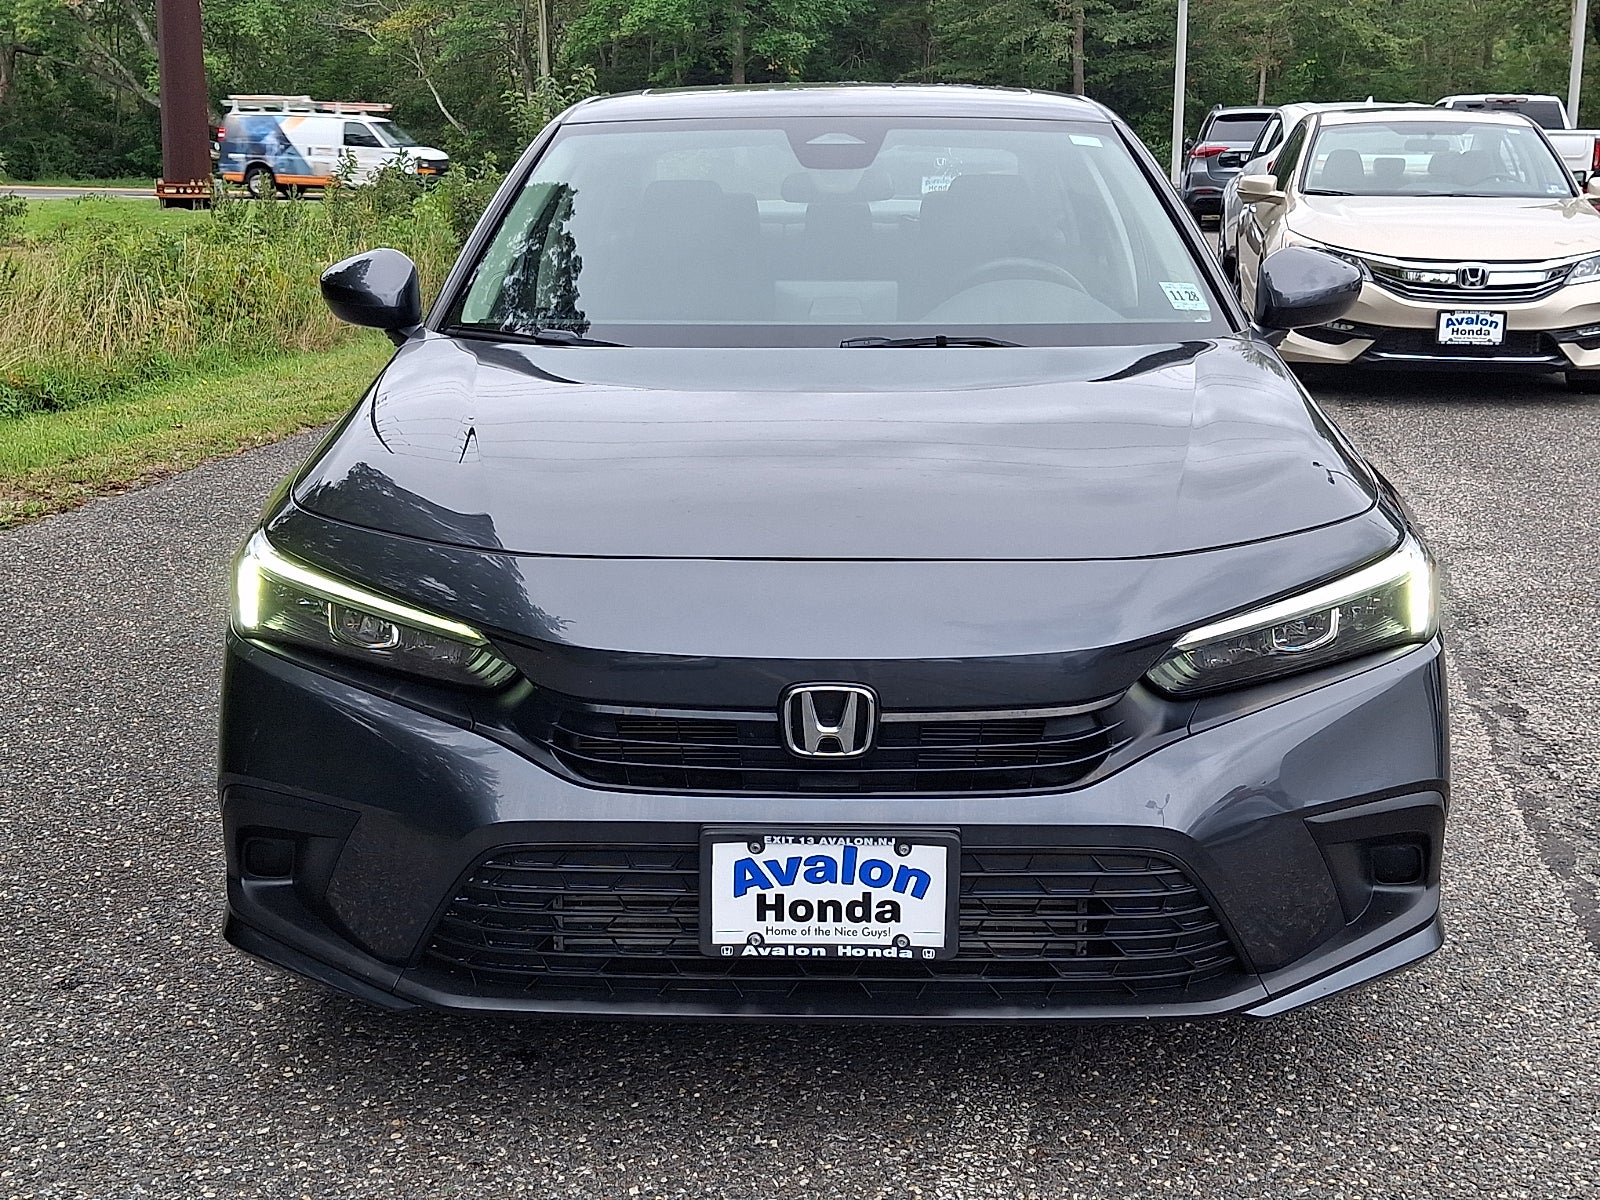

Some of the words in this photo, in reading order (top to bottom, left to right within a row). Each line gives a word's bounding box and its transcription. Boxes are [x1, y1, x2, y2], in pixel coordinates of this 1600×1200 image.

[1185, 290, 1200, 301] 28
[1445, 314, 1499, 329] Avalon
[1451, 327, 1490, 336] Honda
[763, 835, 795, 845] EXIT
[799, 837, 815, 846] 13
[733, 845, 931, 900] Avalon
[756, 891, 902, 923] Honda
[765, 925, 797, 937] Home
[800, 925, 812, 937] of
[814, 926, 831, 937] the
[834, 926, 858, 937] Nice
[861, 927, 891, 938] Guys!
[741, 945, 826, 956] Avalon
[837, 945, 913, 958] Honda
